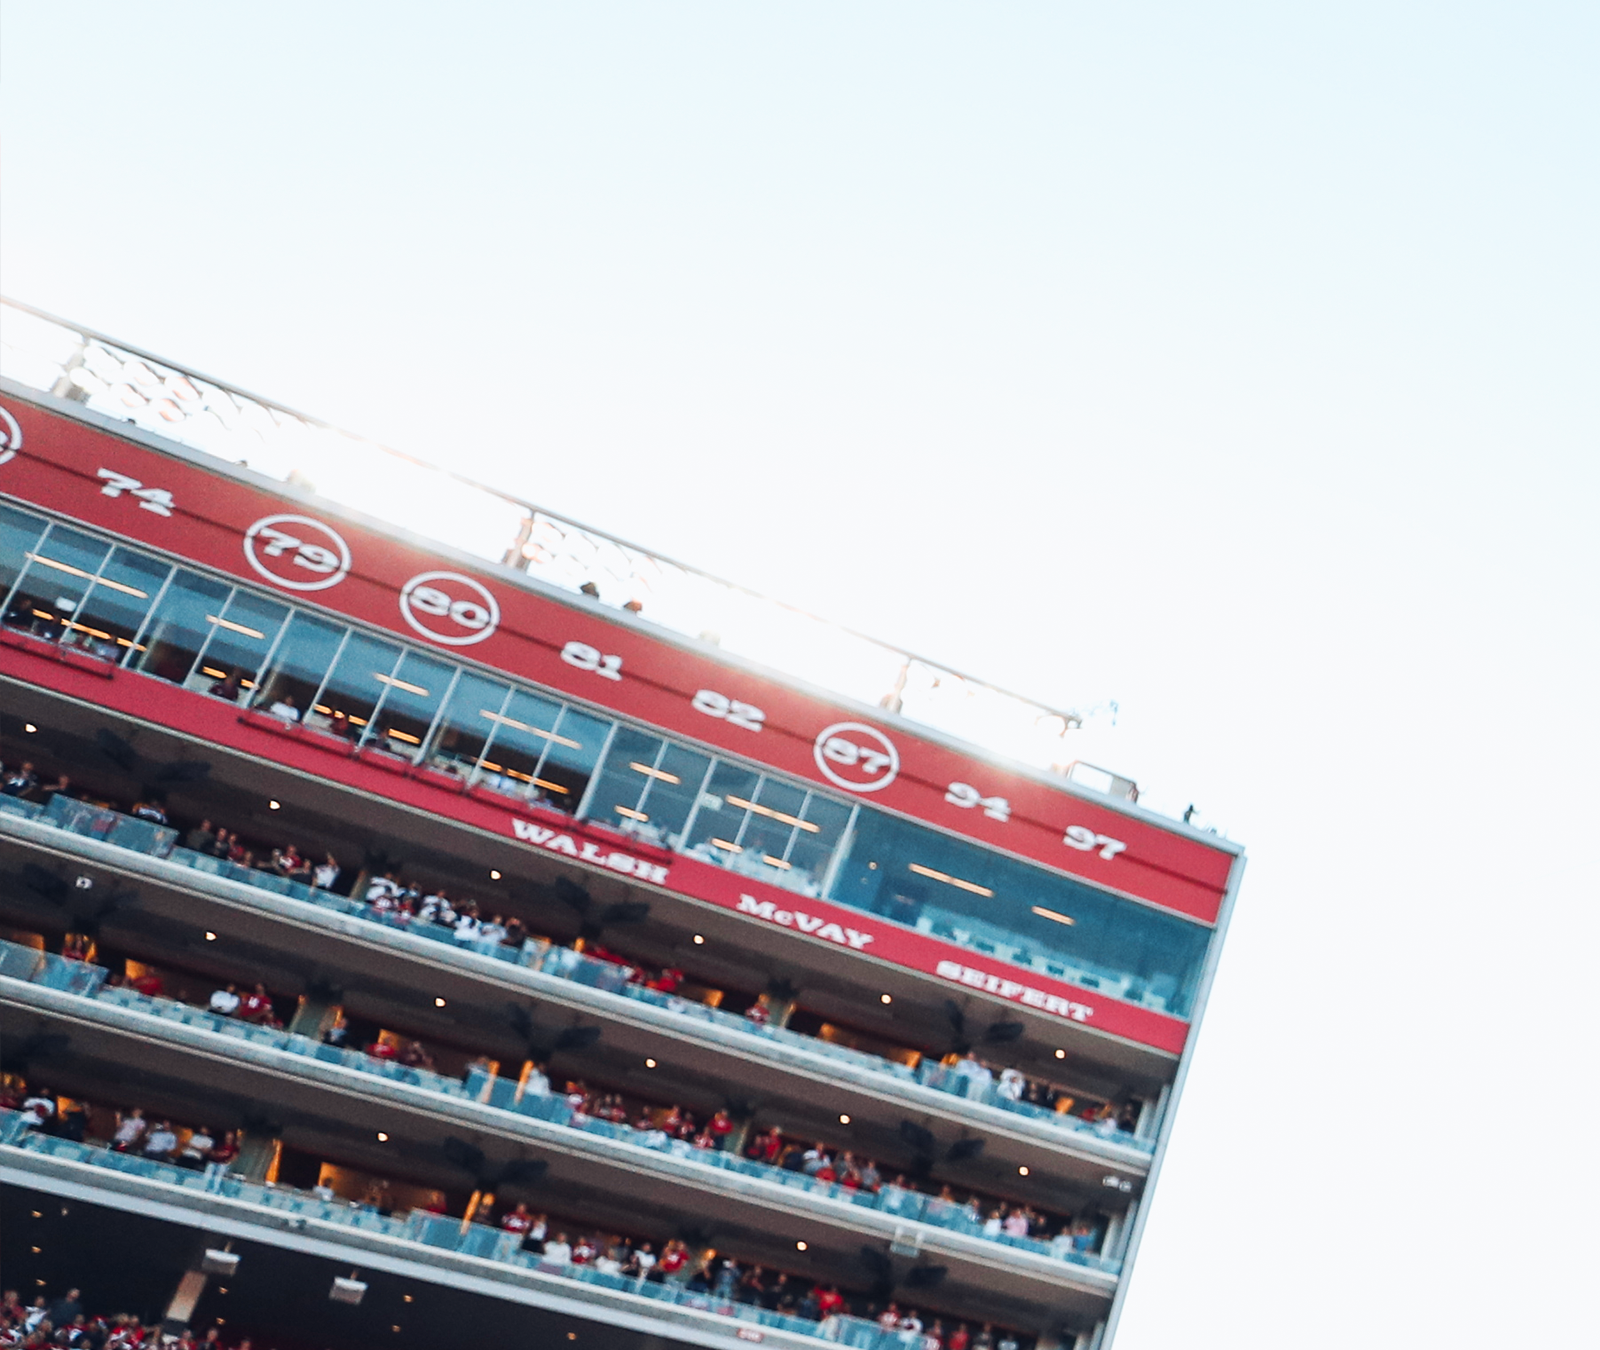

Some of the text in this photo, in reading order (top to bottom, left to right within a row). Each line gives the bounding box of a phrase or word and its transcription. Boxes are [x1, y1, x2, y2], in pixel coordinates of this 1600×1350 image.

[97, 468, 175, 517] 74
[260, 527, 340, 574] 79
[560, 641, 623, 681] 81
[945, 781, 1012, 823] 94
[511, 817, 671, 885] WALSH
[1062, 825, 1127, 861] 97
[736, 893, 875, 951] McVAY
[936, 961, 1095, 1023] SEIFERT
